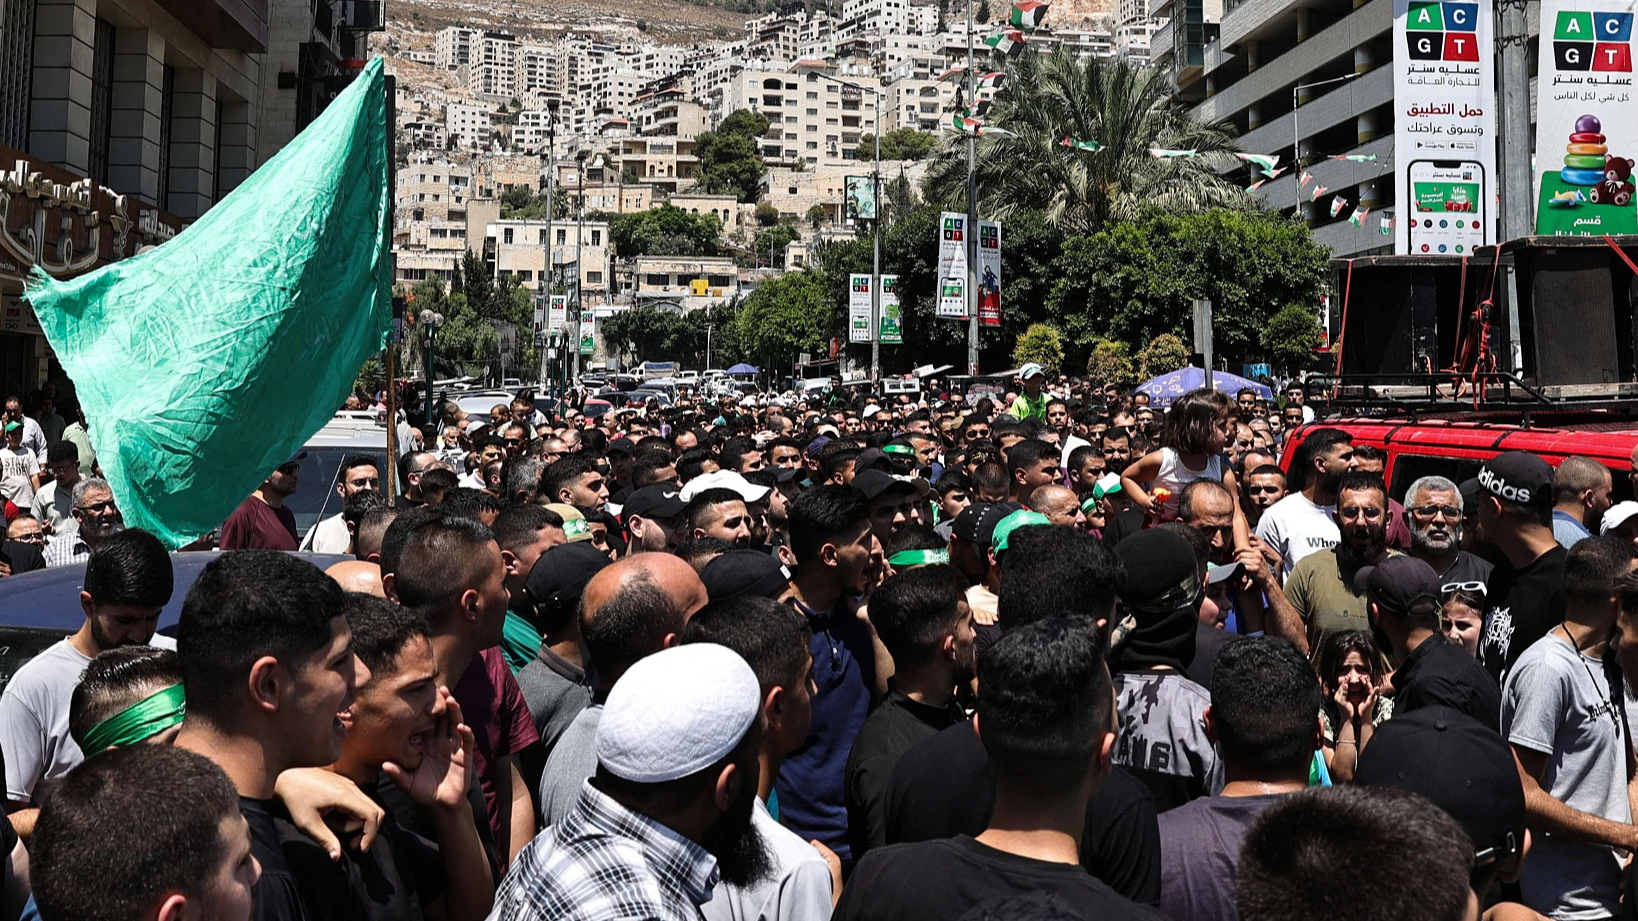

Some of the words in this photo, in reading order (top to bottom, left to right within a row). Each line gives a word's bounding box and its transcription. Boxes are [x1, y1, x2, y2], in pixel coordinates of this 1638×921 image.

[1418, 9, 1431, 23] A
[1453, 9, 1466, 24] C
[1567, 18, 1580, 33] A
[1606, 19, 1619, 34] C
[1418, 38, 1431, 53] G
[1454, 39, 1465, 54] T
[1565, 48, 1579, 63] G
[1605, 49, 1617, 64] T
[1407, 63, 1435, 75] سنتر
[1447, 76, 1480, 88] للتجارة
[1552, 74, 1583, 86] سنتر
[1554, 91, 1578, 101] الناس
[1581, 91, 1596, 101] لكل
[1618, 92, 1629, 102] كل
[1407, 102, 1455, 118] التطبيق
[1459, 103, 1483, 118] حمل
[1407, 122, 1443, 135] عراحتك
[1447, 123, 1484, 137] وتسوق
[1574, 215, 1601, 227] قسم
